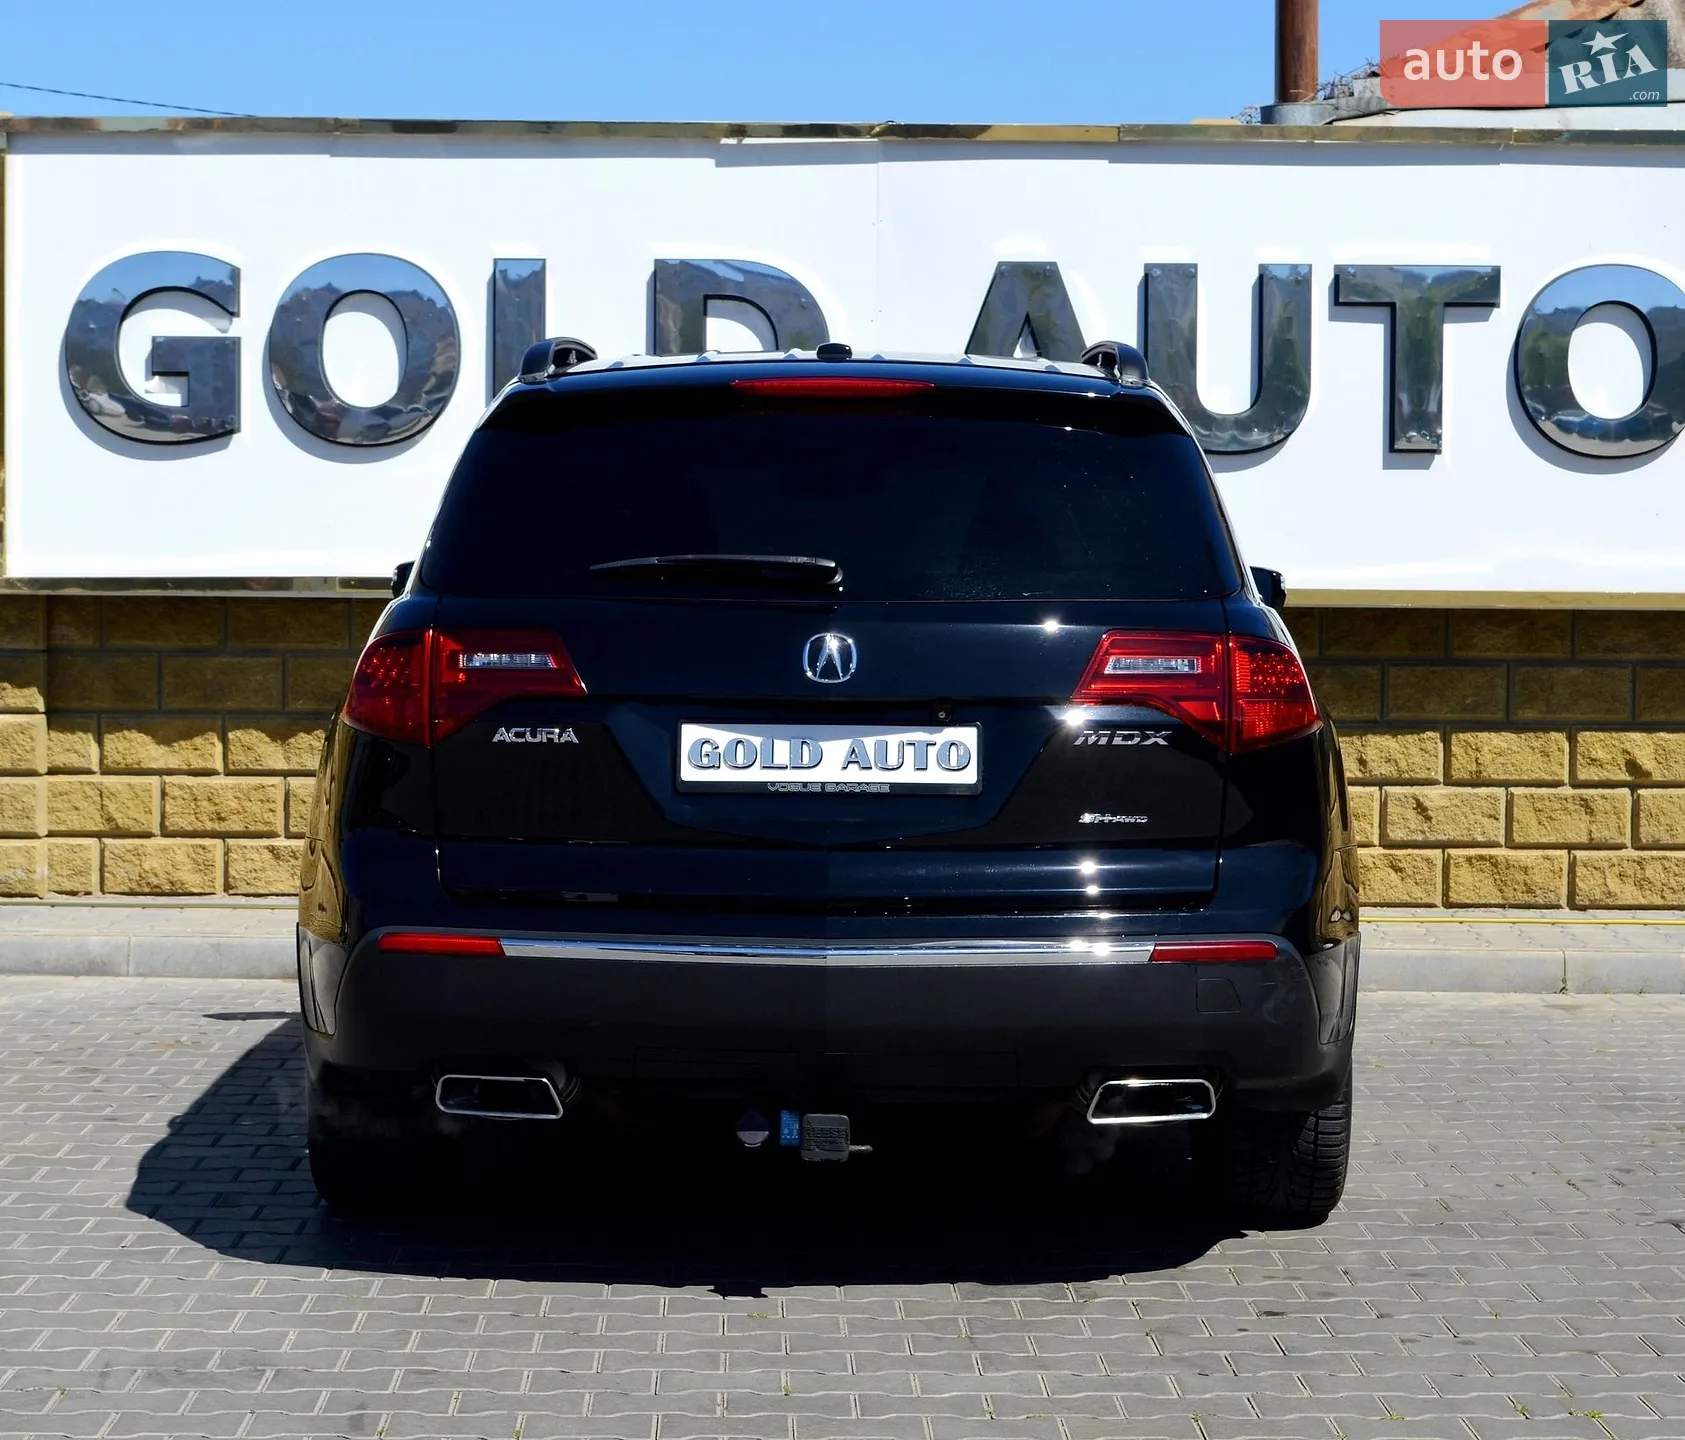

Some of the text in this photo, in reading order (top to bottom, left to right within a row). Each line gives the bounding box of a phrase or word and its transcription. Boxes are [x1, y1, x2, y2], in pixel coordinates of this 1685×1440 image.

[492, 727, 580, 744] ACURA
[1073, 730, 1173, 746] MDX
[687, 737, 971, 770] GOLD AUTO
[767, 782, 891, 793] VOGUE GARAGE
